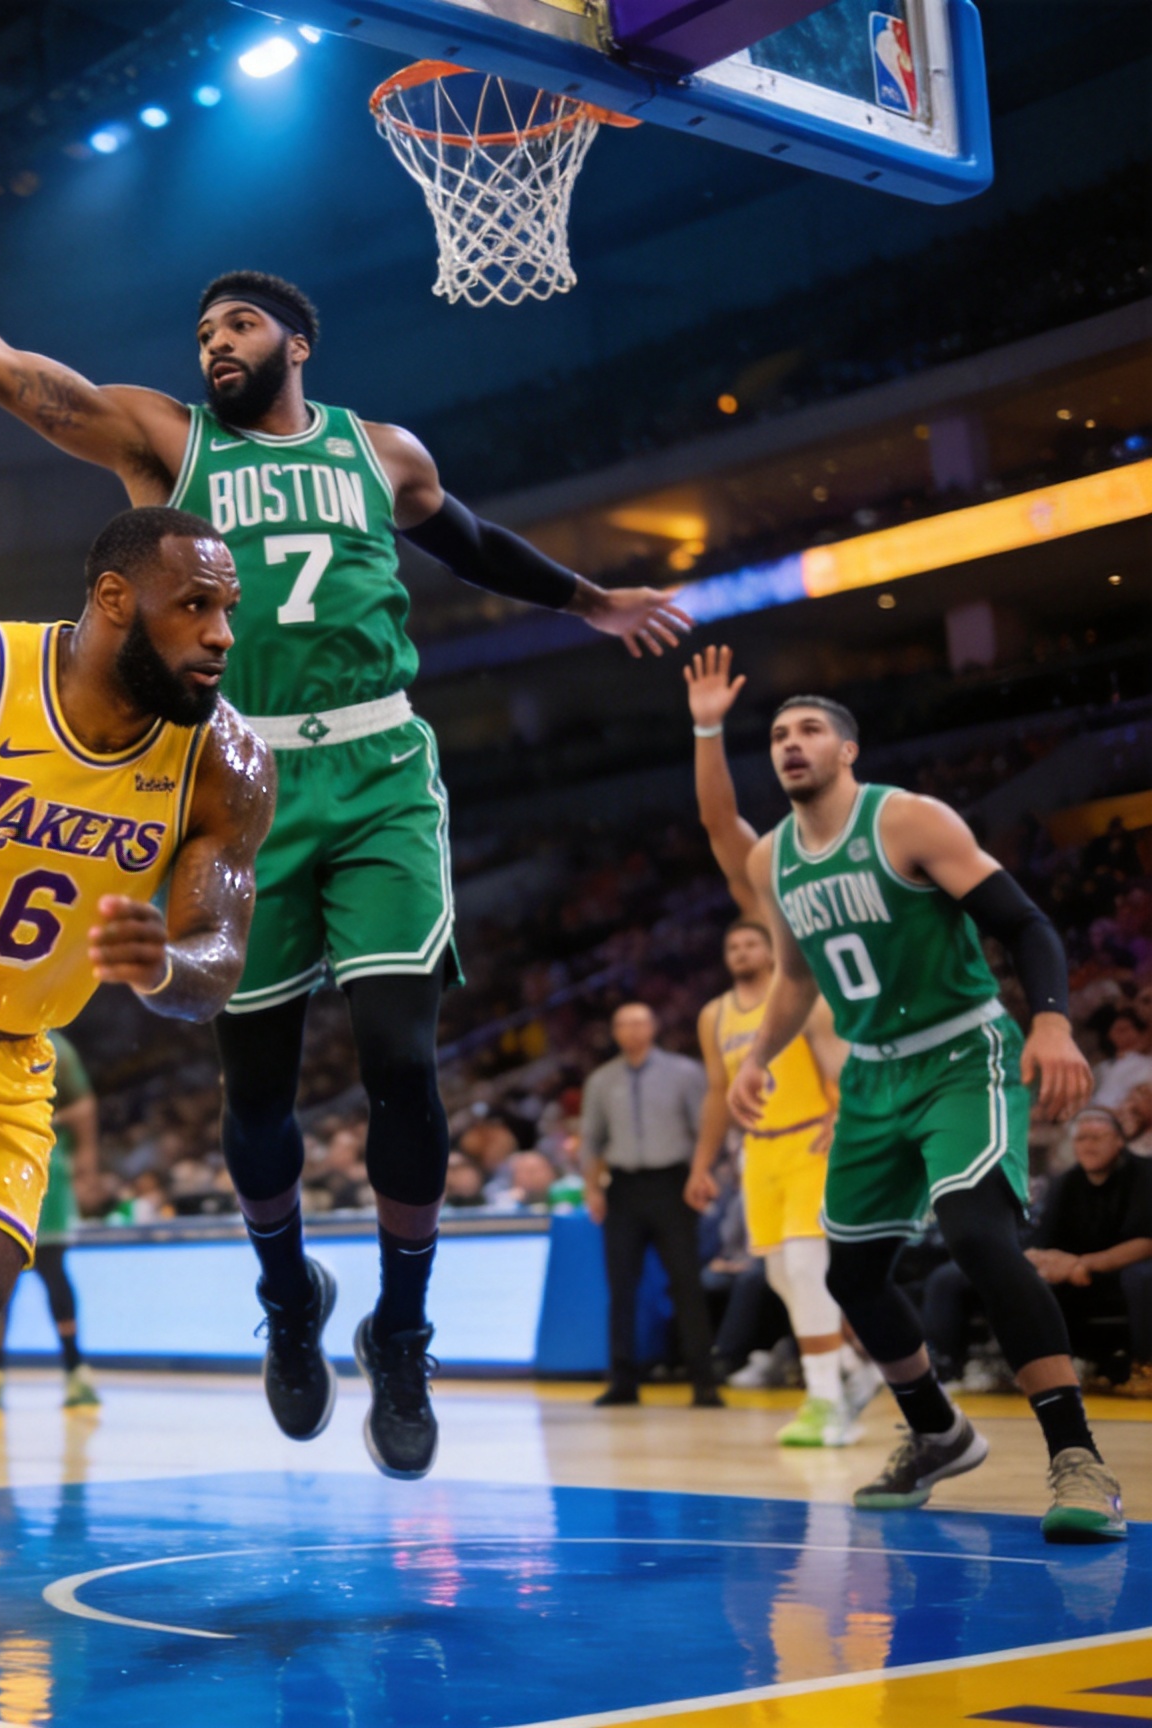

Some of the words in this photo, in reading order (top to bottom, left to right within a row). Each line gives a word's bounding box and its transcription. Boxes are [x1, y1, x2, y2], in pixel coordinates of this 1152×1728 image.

[209, 463, 368, 534] BOSTON
[264, 534, 333, 624] 7
[824, 933, 881, 1000] 0
